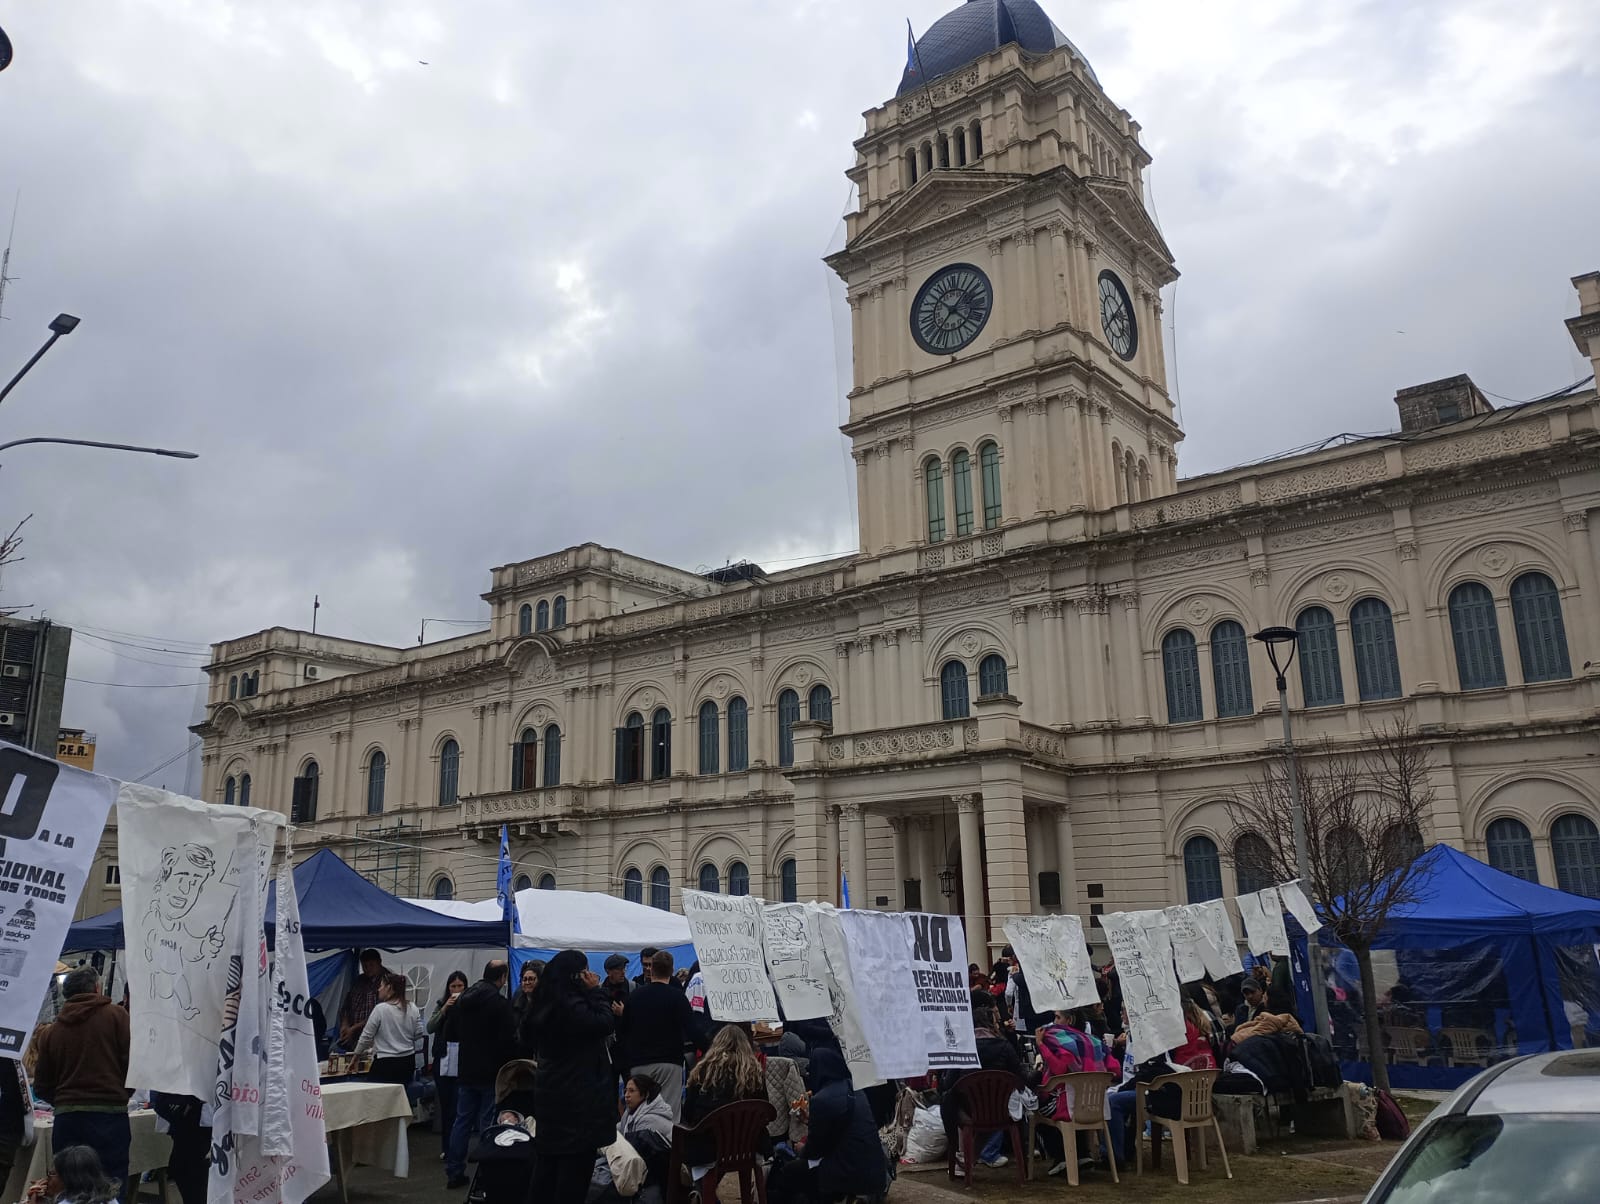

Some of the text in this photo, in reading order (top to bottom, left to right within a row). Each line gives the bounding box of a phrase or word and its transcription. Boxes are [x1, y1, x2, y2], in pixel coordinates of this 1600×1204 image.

[58, 744, 88, 757] P.E.R.
[38, 829, 75, 849] A LA
[0, 879, 67, 905] OS TODOS
[911, 915, 952, 962] NO
